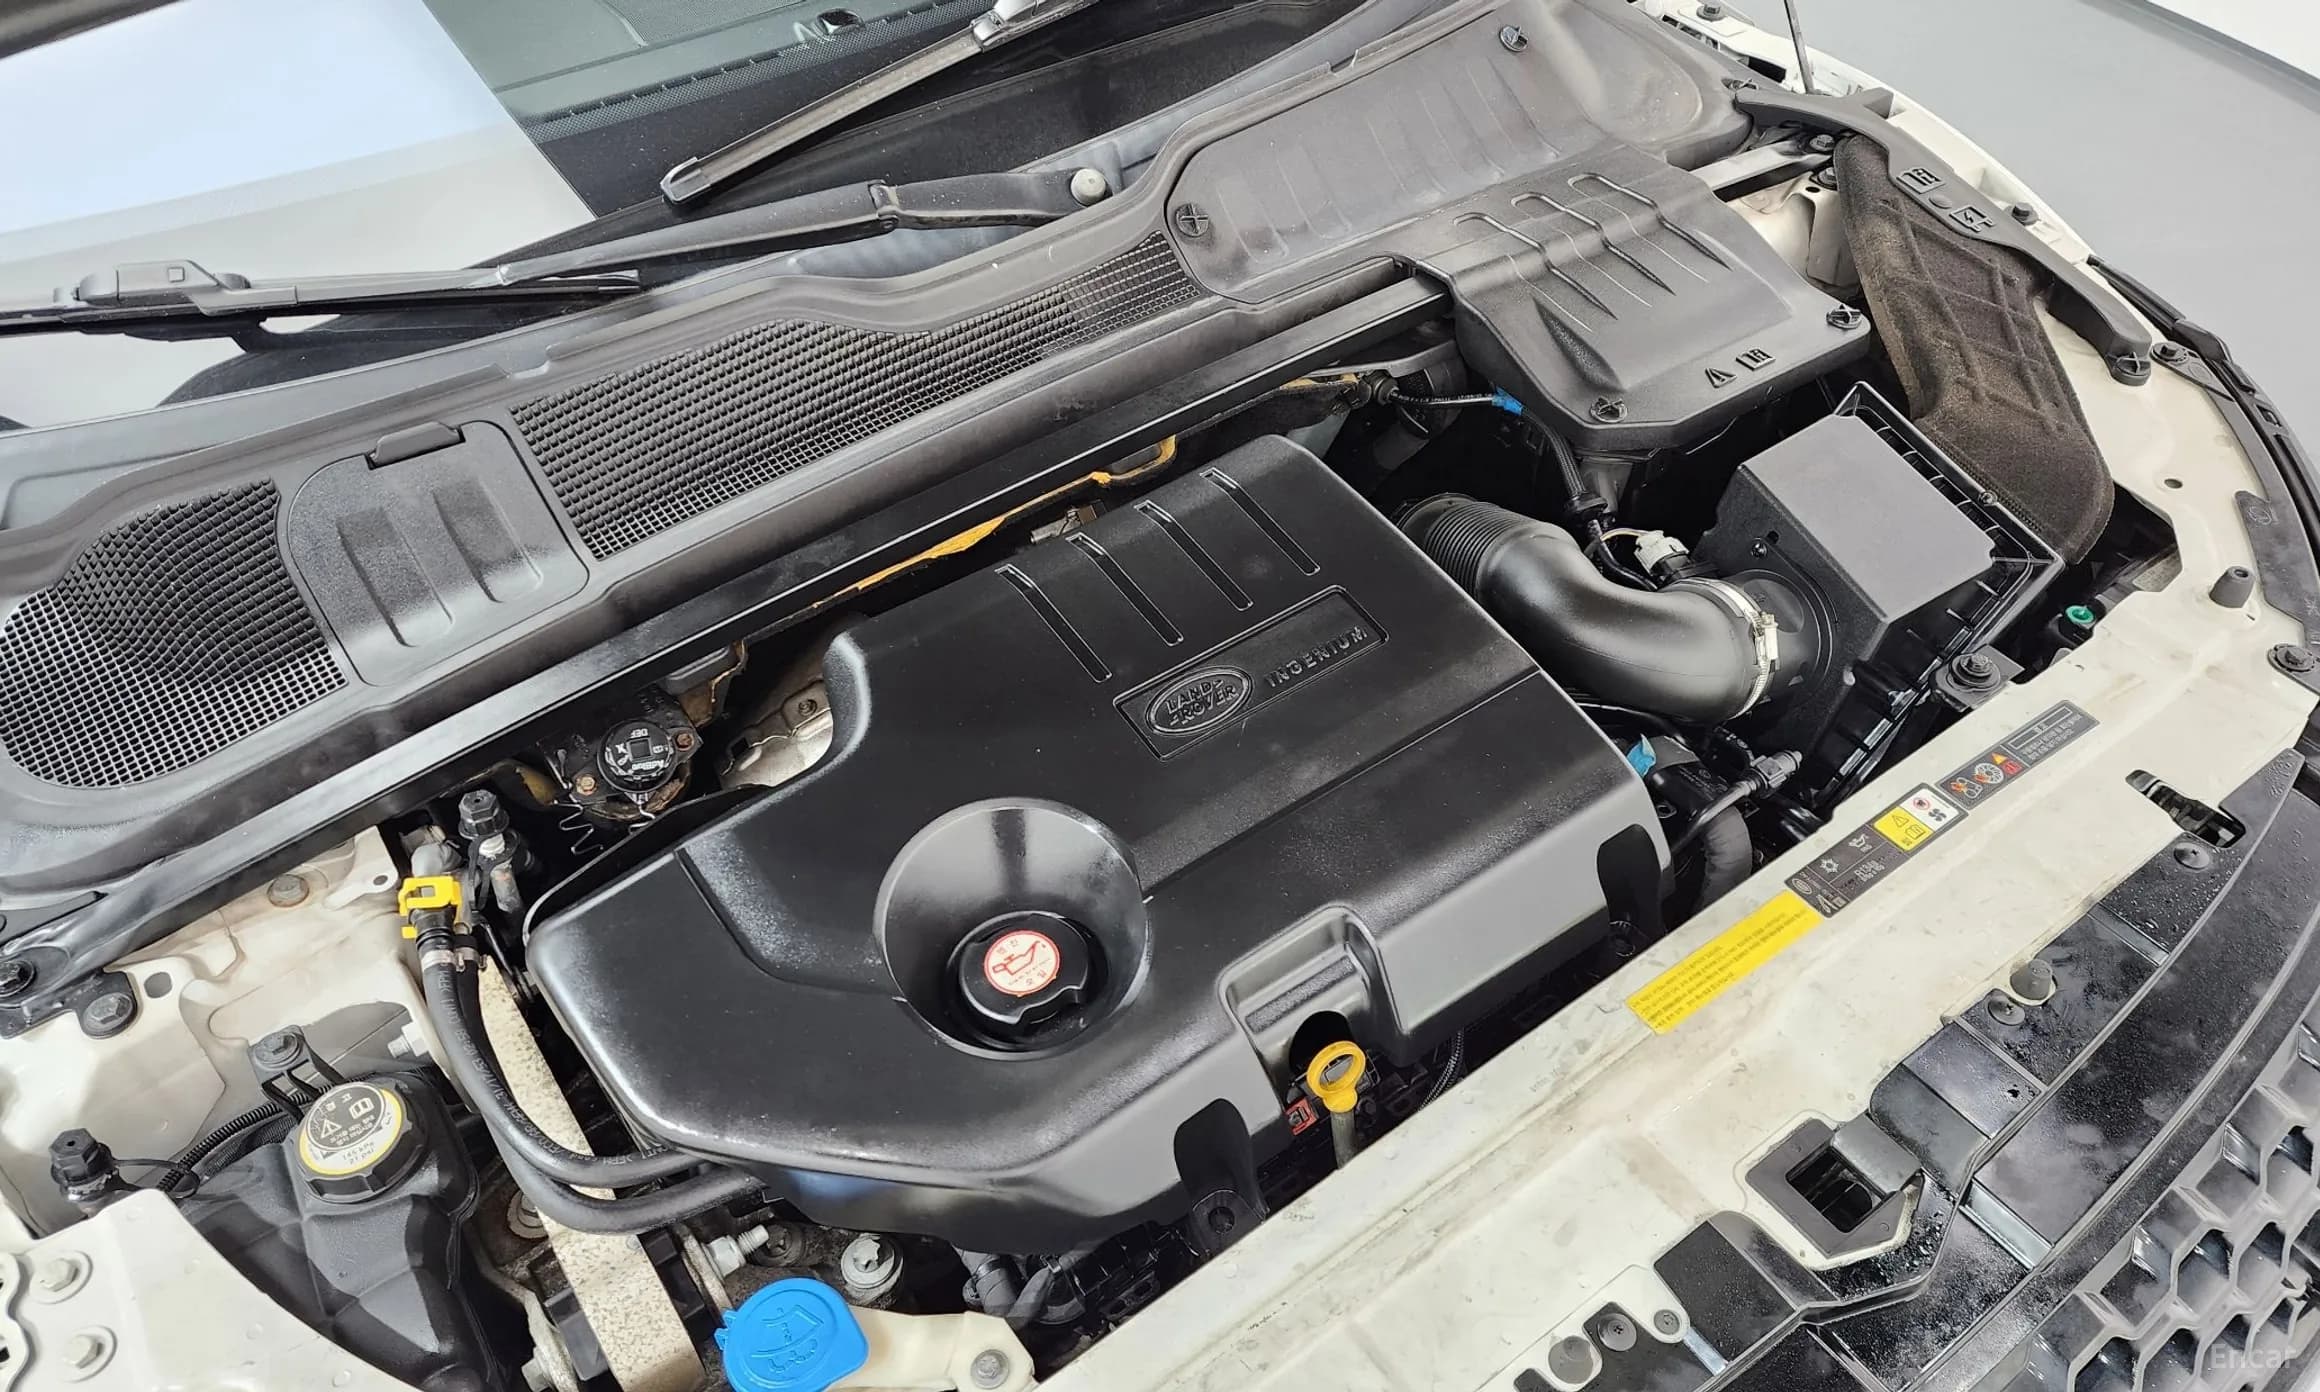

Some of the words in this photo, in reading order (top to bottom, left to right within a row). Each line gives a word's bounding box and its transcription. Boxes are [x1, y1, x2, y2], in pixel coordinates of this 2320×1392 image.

[1265, 625, 1368, 688] INGENIUM
[1165, 681, 1214, 714] LAND
[1180, 684, 1240, 725] ROVER
